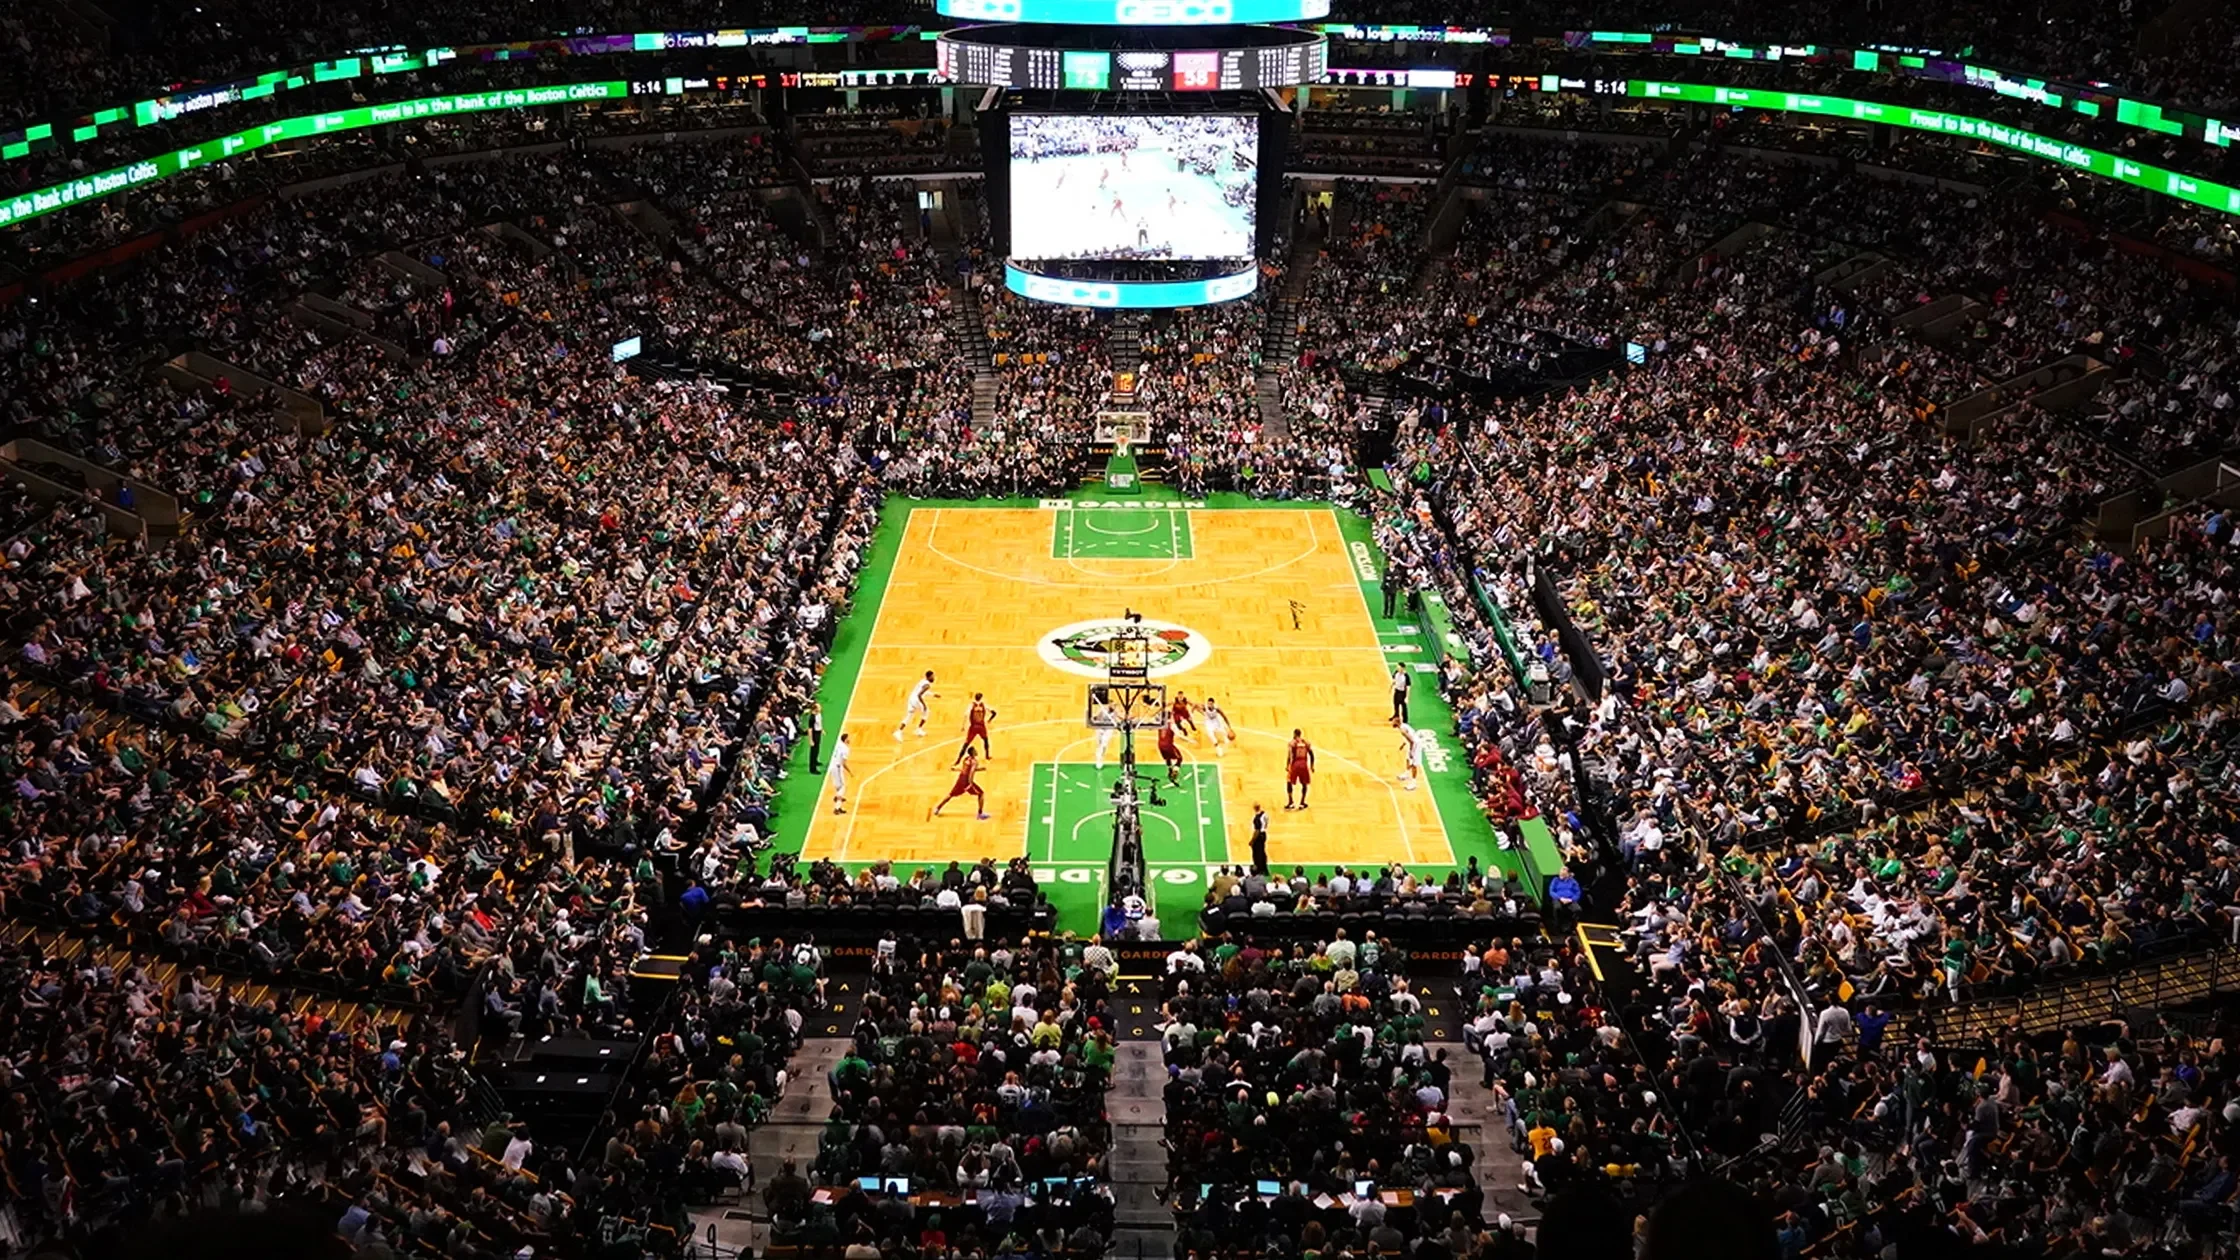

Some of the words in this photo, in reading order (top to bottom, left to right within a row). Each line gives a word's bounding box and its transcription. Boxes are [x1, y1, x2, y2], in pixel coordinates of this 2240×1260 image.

[633, 80, 661, 94] 5:14
[1594, 80, 1626, 94] 5:14
[402, 104, 414, 116] to
[415, 101, 429, 114] be
[431, 98, 453, 112] the
[455, 97, 486, 109] Bank
[488, 93, 502, 106] of
[504, 91, 524, 105] the
[527, 89, 566, 102] Boston
[569, 84, 608, 98] Celtics
[1910, 111, 1943, 129] Proud
[1944, 116, 1958, 131] to
[1960, 117, 1975, 134] be
[1977, 121, 1991, 138] the
[2011, 130, 2020, 146] of
[2021, 132, 2033, 151] the
[2063, 144, 2091, 168] Celtics
[12, 198, 33, 218] the
[33, 188, 61, 211] Bank
[62, 183, 74, 203] of
[75, 180, 93, 199] the
[93, 171, 128, 194] Boston
[128, 162, 158, 183] Celtics
[1077, 500, 1205, 508] GARDEN
